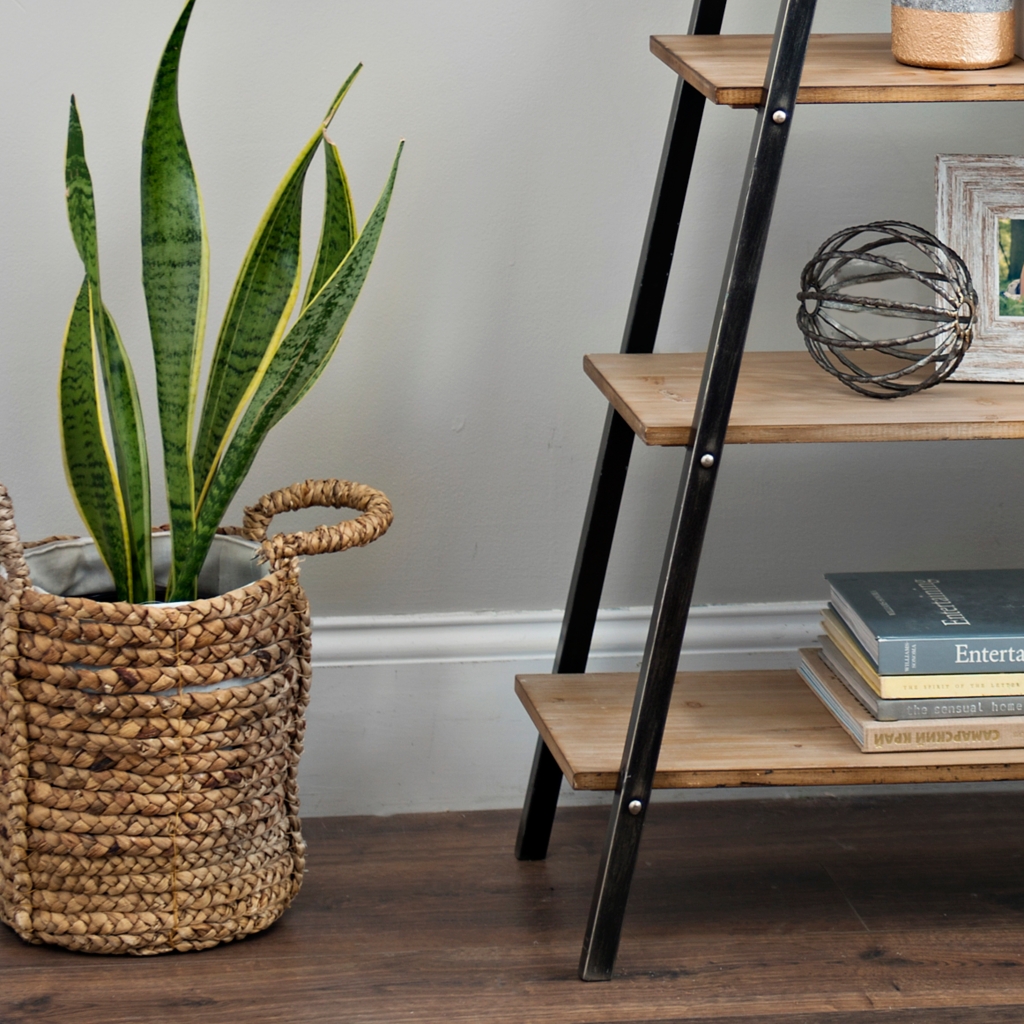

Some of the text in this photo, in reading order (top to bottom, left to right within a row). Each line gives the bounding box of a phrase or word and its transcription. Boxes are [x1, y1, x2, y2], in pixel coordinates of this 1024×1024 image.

[907, 701, 1023, 716] the sensual home
[873, 731, 912, 749] КРАЙ
[915, 728, 1001, 746] САМАРСКИЙ
